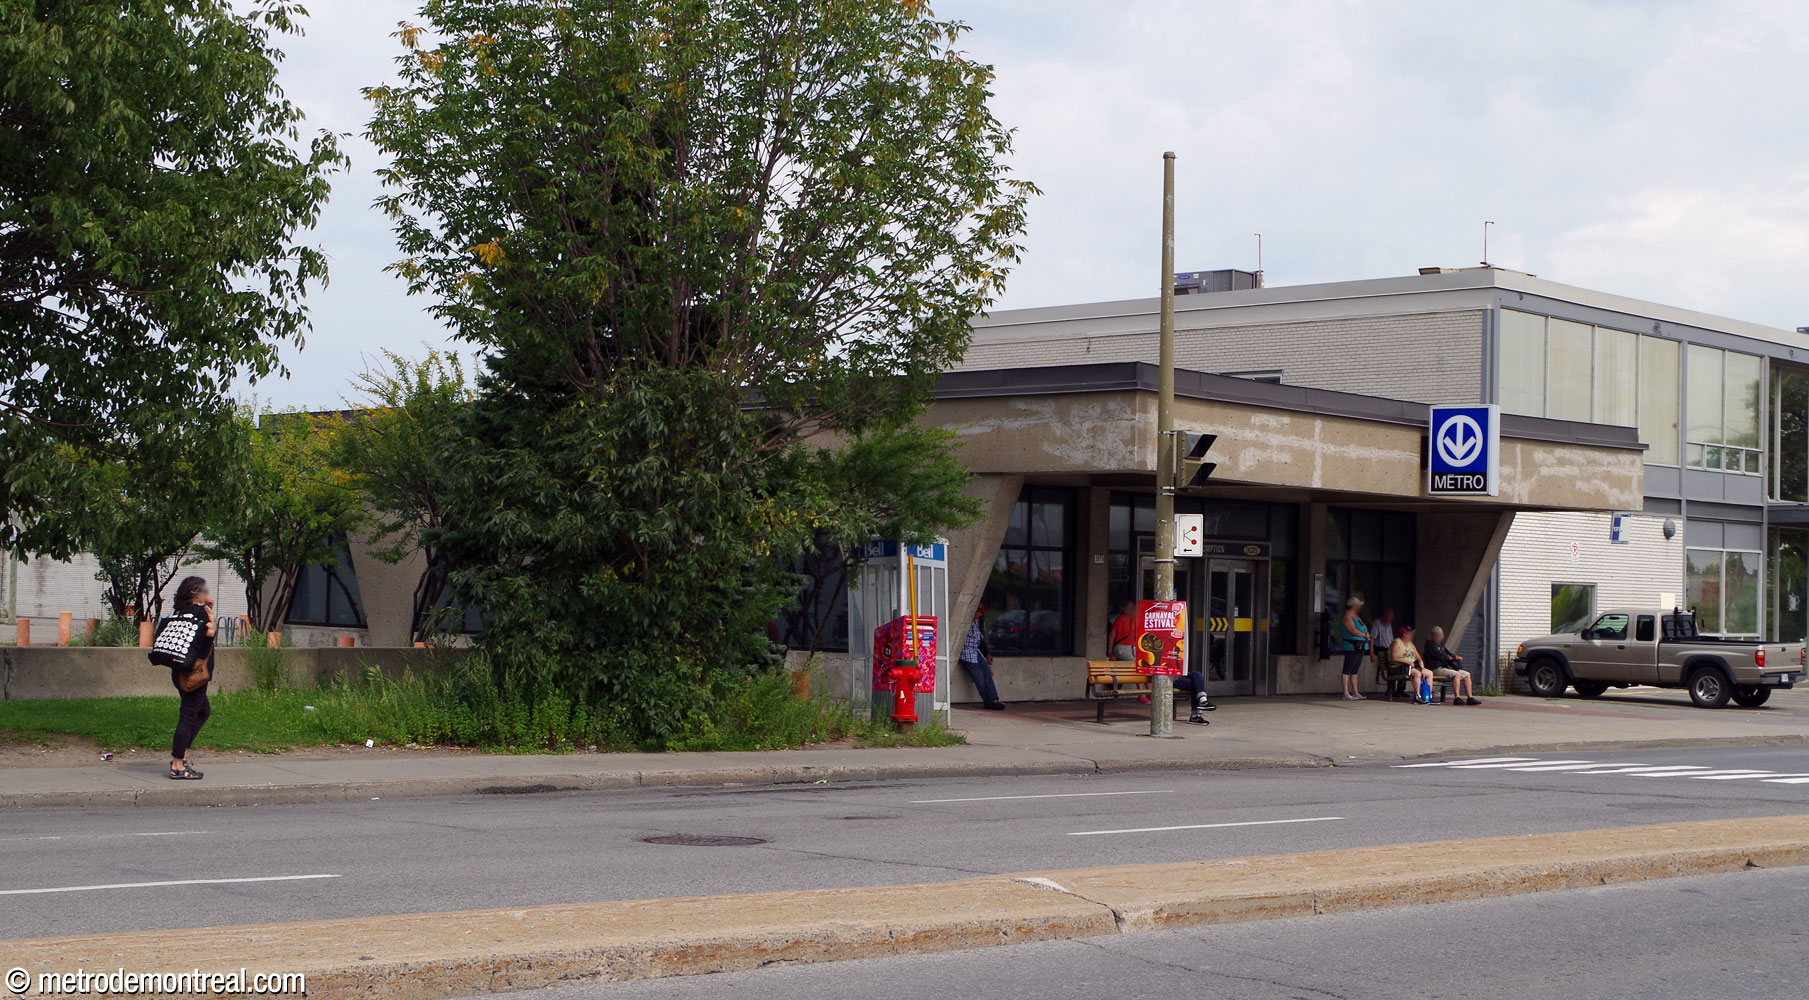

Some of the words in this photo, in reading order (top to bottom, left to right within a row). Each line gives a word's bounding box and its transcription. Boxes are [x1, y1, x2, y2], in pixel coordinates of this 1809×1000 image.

[864, 541, 884, 557] Bell
[916, 543, 933, 559] Bell
[1144, 612, 1175, 620] CARNAVAL
[1144, 619, 1175, 628] ESTIVAL
